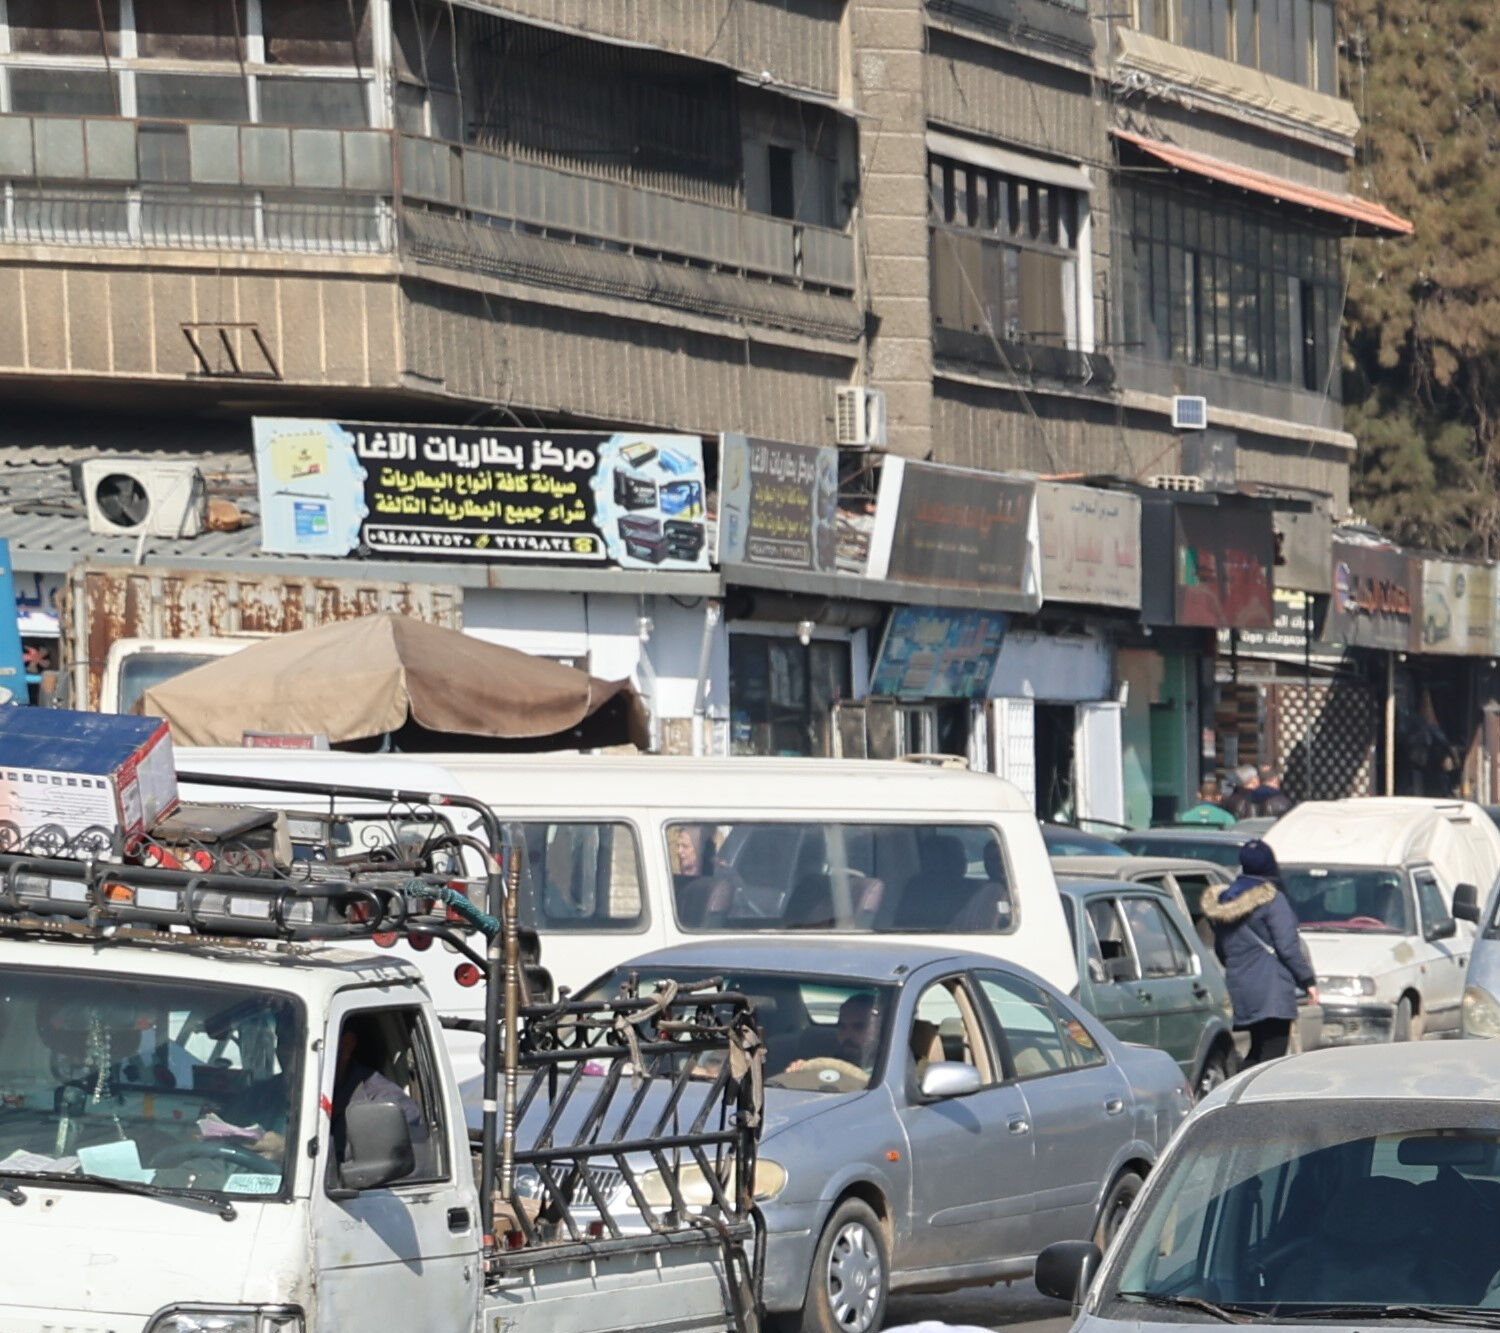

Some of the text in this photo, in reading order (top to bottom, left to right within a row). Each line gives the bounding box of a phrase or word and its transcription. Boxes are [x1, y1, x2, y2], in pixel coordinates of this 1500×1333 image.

[423, 436, 524, 469] بطاريات
[530, 440, 596, 472] مركز
[380, 467, 577, 498] صيانة كافة أنواع البطاريات
[374, 493, 586, 525] شراء جميع البطاريات التالفة
